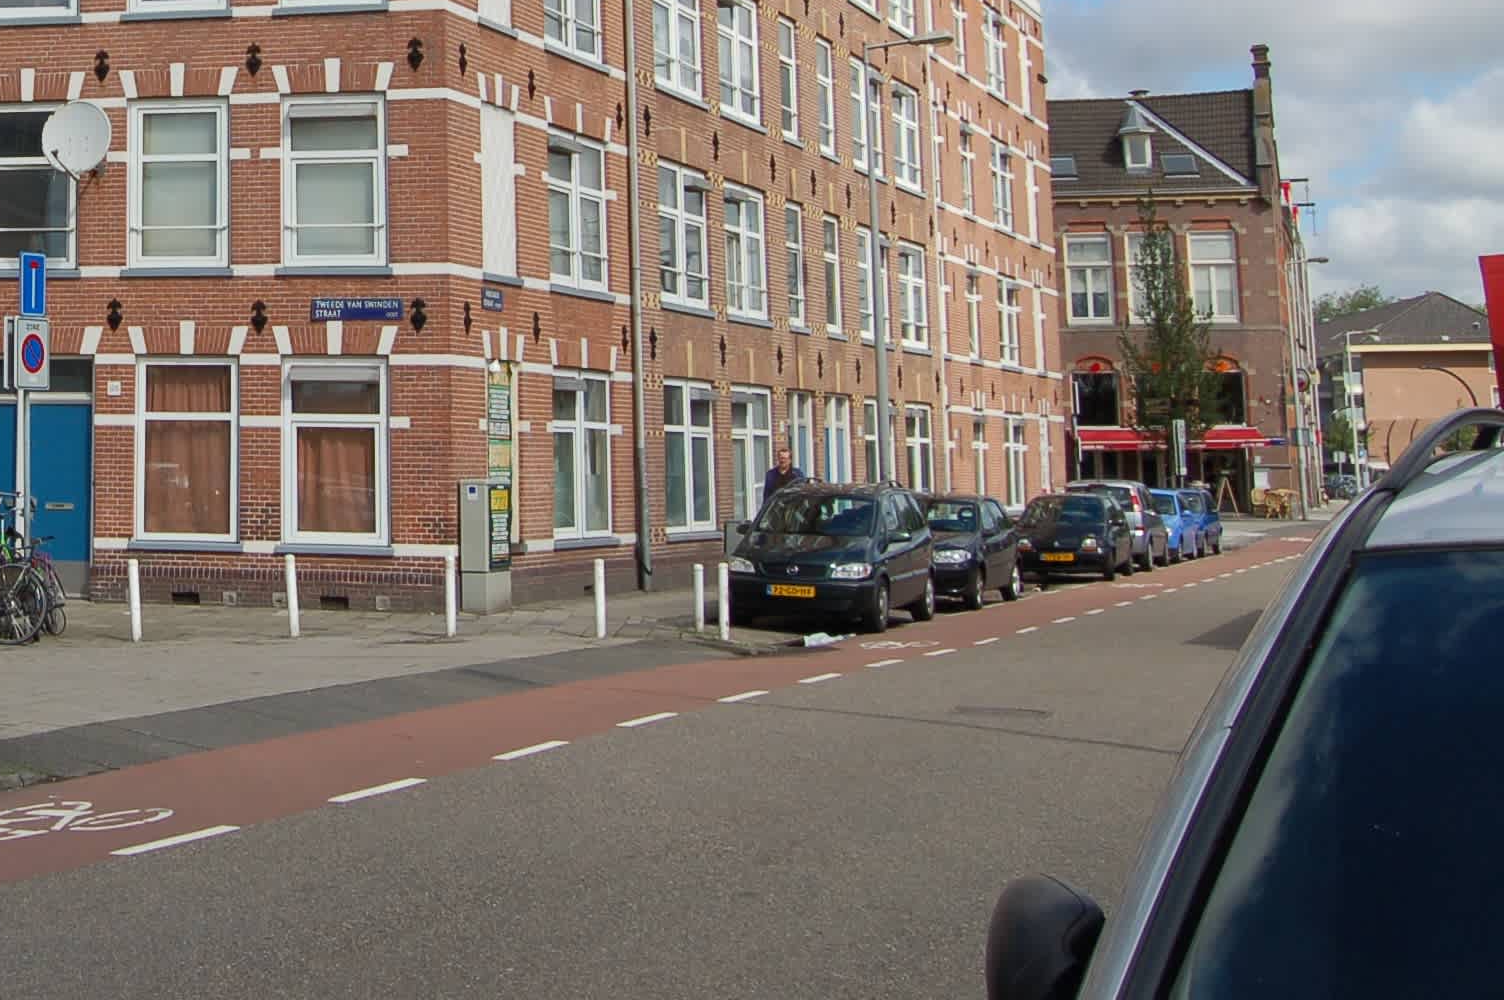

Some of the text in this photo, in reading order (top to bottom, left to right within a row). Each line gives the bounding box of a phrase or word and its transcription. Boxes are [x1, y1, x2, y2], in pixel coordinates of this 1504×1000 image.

[315, 300, 399, 309] TWEEDE VAN SWINDEN
[315, 309, 342, 319] STRAAT
